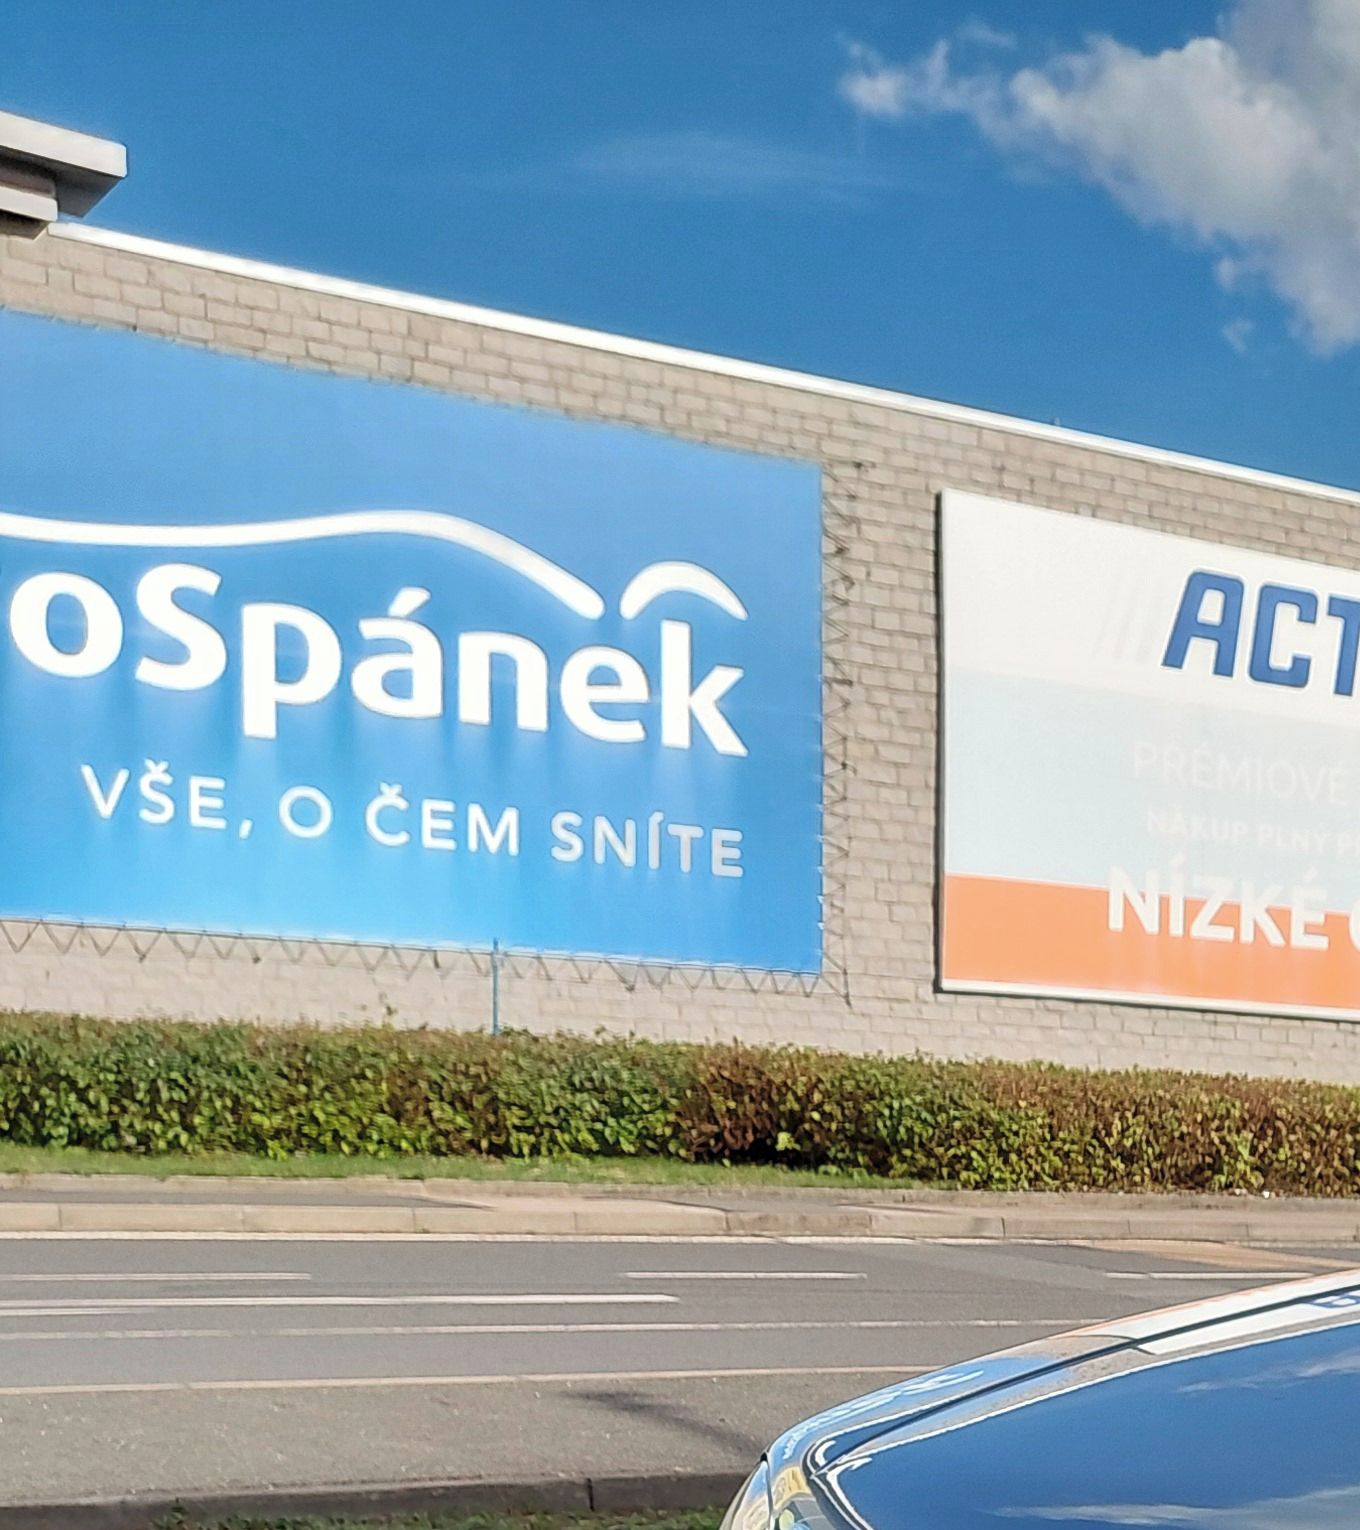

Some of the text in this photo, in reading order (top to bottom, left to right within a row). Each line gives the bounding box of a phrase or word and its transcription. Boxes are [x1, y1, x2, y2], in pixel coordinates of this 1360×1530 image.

[80, 758, 745, 878] VŠE, O ČEM SNÍTE
[1144, 803, 1250, 844] NÁKUP
[1257, 819, 1329, 855] PLNÝ
[1107, 853, 1329, 950] NÍZKÉ
